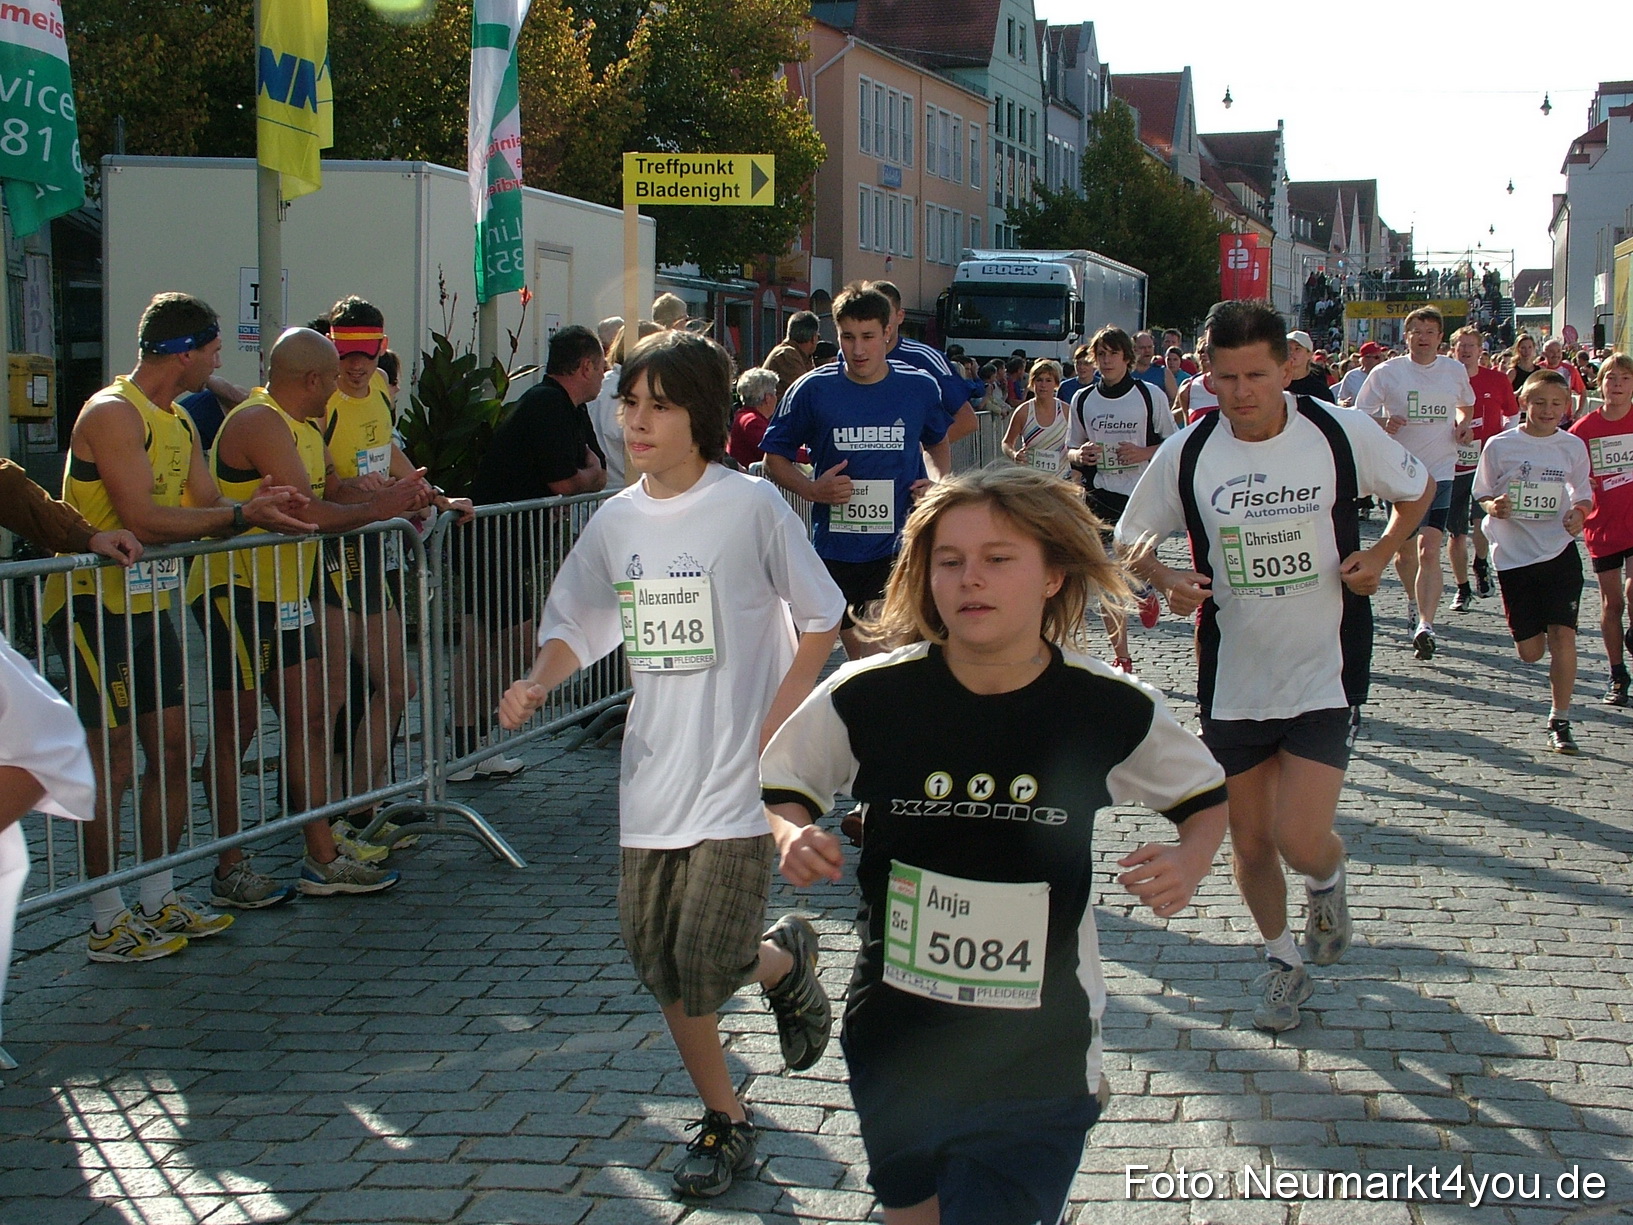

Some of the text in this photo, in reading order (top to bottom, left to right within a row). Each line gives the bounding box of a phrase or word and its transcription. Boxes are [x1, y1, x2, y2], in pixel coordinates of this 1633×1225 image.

[1, 3, 63, 39] meis
[635, 158, 734, 178] Treffpunkt
[636, 182, 740, 201] Bladenight
[982, 264, 1038, 276] BOCK
[1420, 405, 1447, 415] 5160
[1099, 421, 1138, 429] Fischer
[833, 427, 905, 442] HUBER
[1035, 460, 1056, 470] 5113
[1230, 486, 1321, 509] Fischer
[1523, 496, 1556, 509] 5130
[847, 504, 888, 518] 5039
[1244, 503, 1320, 519] Automobile
[1245, 530, 1301, 546] Christian
[1252, 552, 1312, 578] 5038
[639, 587, 699, 605] Alexander
[643, 619, 704, 645] 5148
[927, 885, 970, 918] Anja
[892, 910, 1031, 972] Sc 5084
[977, 987, 1038, 999] PFLEIDERER
